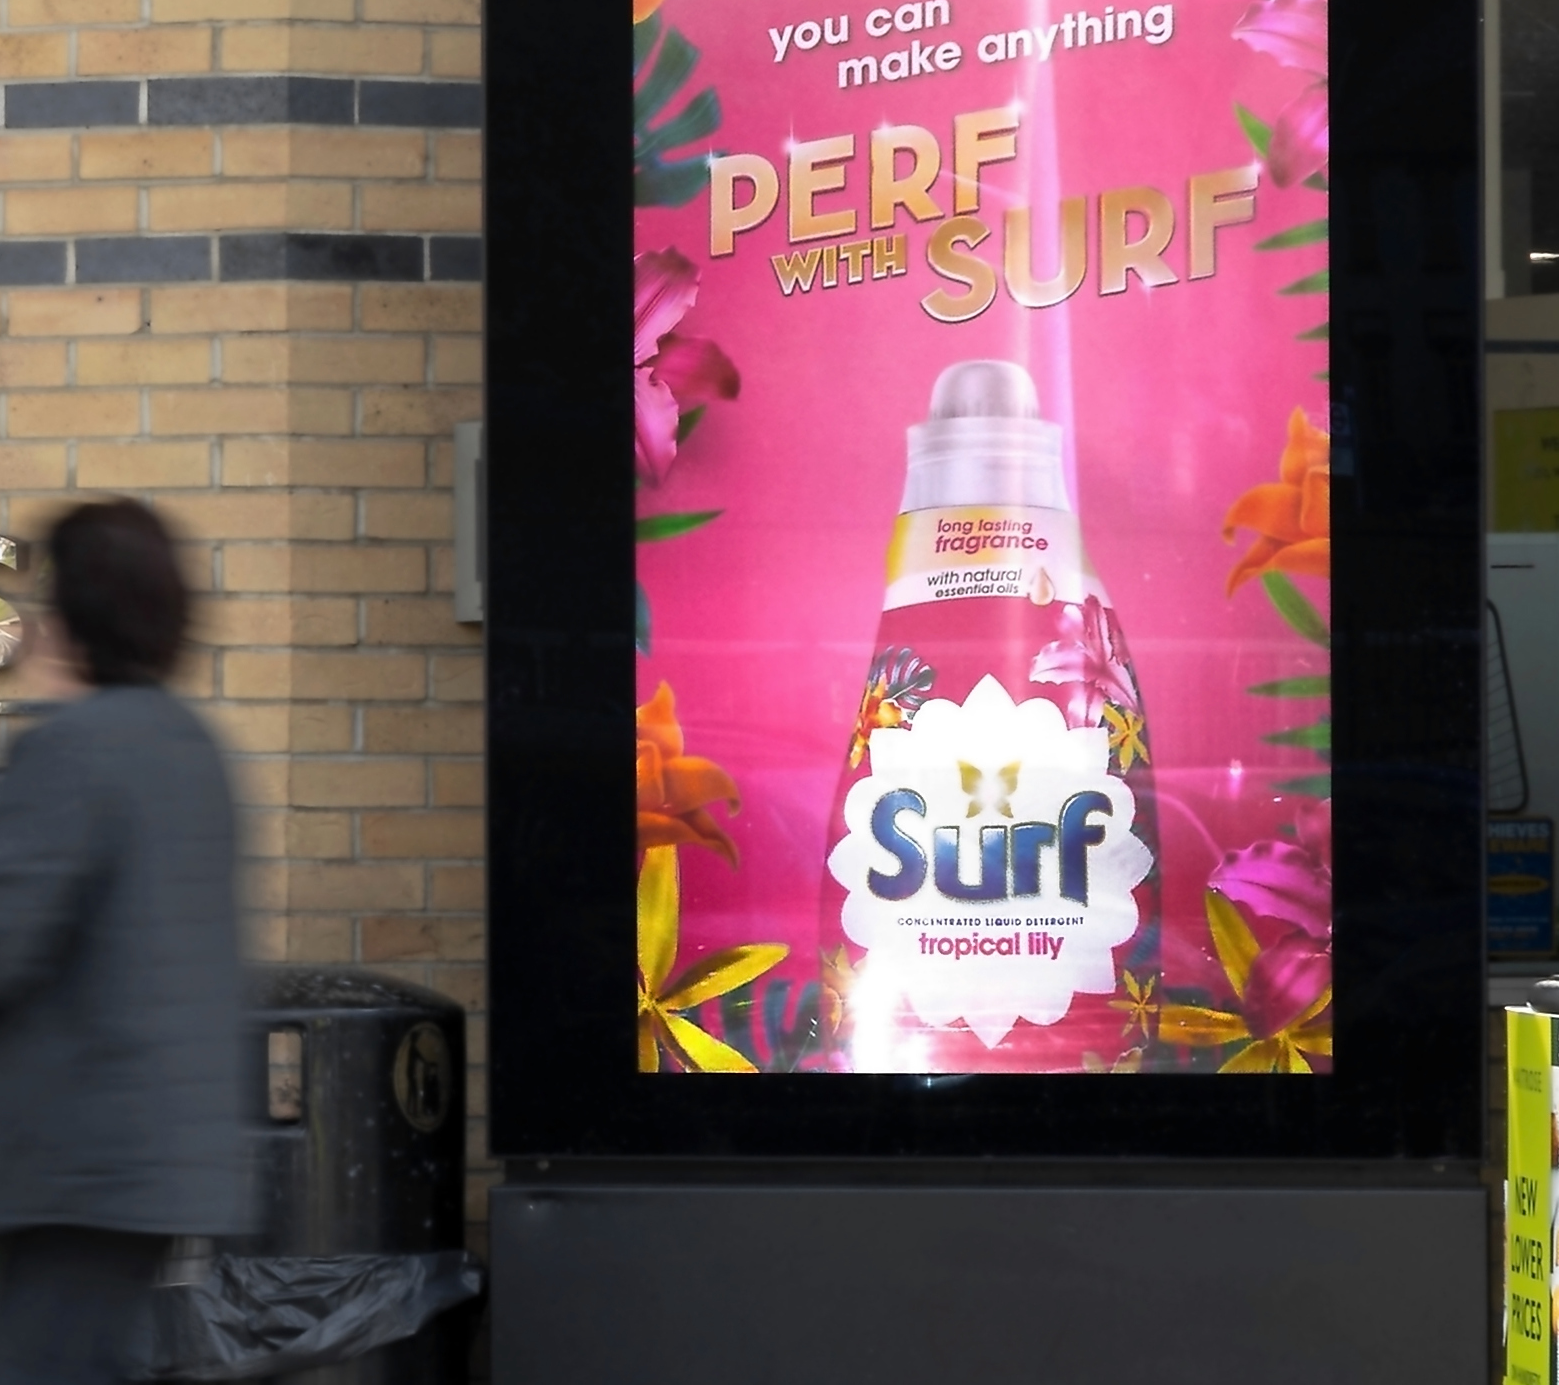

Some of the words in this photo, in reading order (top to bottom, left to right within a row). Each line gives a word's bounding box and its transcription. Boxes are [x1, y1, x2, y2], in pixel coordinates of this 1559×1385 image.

[767, 15, 849, 62] you
[837, 37, 961, 89] make
[977, 0, 1176, 66] anything
[707, 105, 1023, 258] PERF
[773, 233, 909, 297] WITH
[918, 162, 1261, 326] SURF
[935, 535, 1048, 554] fragrance
[937, 519, 973, 535] long
[978, 519, 1032, 534] lasting
[927, 571, 959, 586] with
[963, 568, 1022, 584] natural
[935, 583, 993, 598] essential
[997, 584, 1019, 594] oils
[866, 787, 1114, 909] Surf
[1487, 822, 1550, 838] HIEVES
[898, 917, 981, 926] CONCENTRATED
[985, 918, 1021, 926] LIQUID
[1026, 917, 1084, 926] DETERGENT
[919, 932, 1021, 960] tropical
[1028, 932, 1064, 960] lily
[1514, 1176, 1538, 1217] NEW
[1511, 1234, 1544, 1282] LOWER
[1511, 1293, 1542, 1342] PRICES
